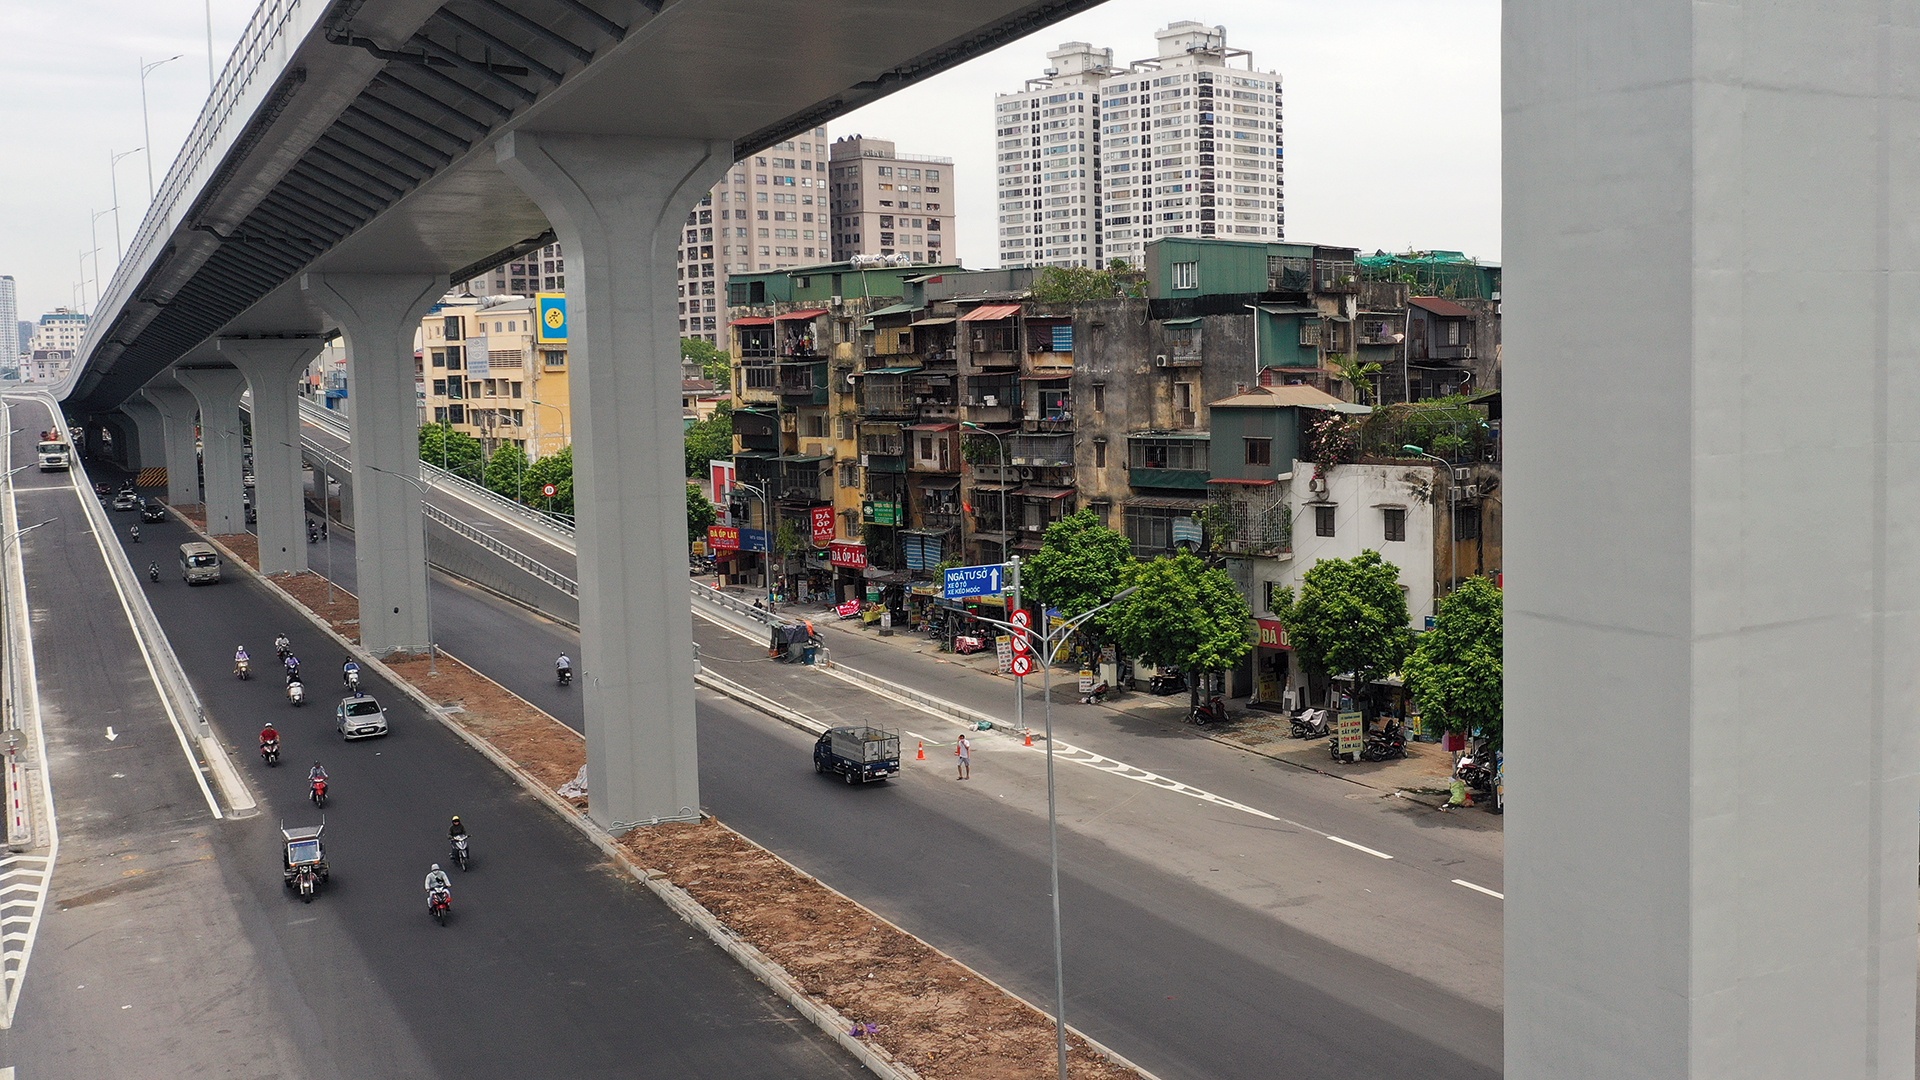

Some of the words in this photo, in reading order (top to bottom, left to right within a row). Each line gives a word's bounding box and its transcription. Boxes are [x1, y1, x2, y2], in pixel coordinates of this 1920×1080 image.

[817, 518, 830, 527] ỐP
[832, 548, 842, 561] ĐÁ
[842, 548, 851, 562] ỐP
[852, 550, 864, 564] LÁT
[948, 571, 964, 581] NGÃ
[964, 570, 976, 580] TƯ
[976, 567, 988, 579] SỞ
[1262, 627, 1277, 644] ĐÁ
